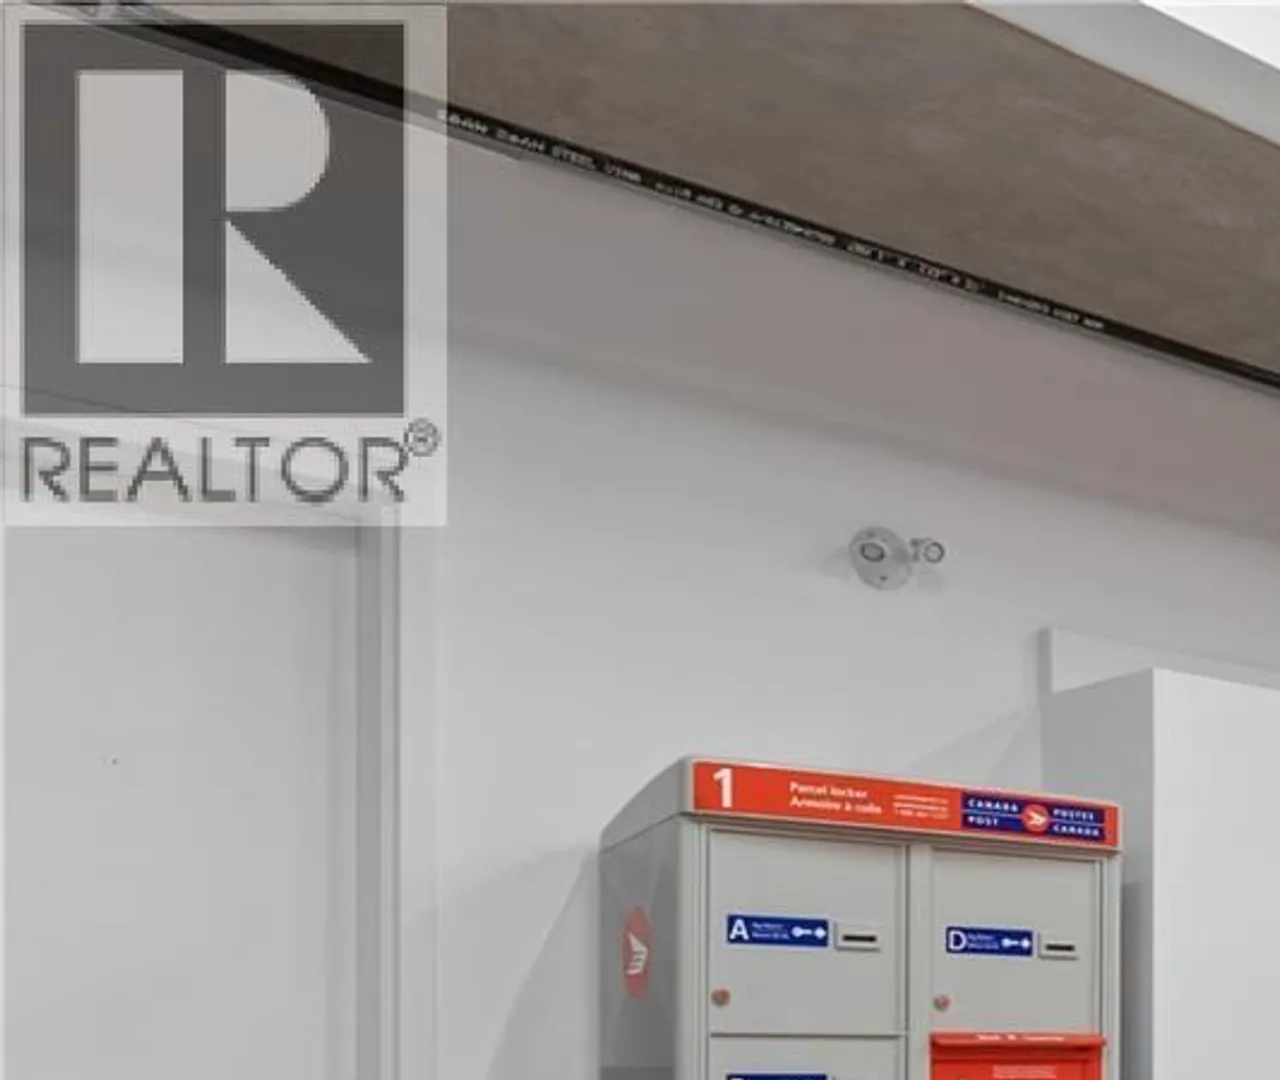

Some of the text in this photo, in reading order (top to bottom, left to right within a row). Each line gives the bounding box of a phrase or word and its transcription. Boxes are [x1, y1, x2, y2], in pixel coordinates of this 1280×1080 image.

[713, 767, 733, 808] 1
[967, 798, 1019, 813] CANADA
[967, 815, 999, 827] POST
[1053, 808, 1095, 821] POSTES
[1053, 823, 1100, 837] CANADA
[729, 918, 750, 940] A
[948, 930, 967, 950] D
